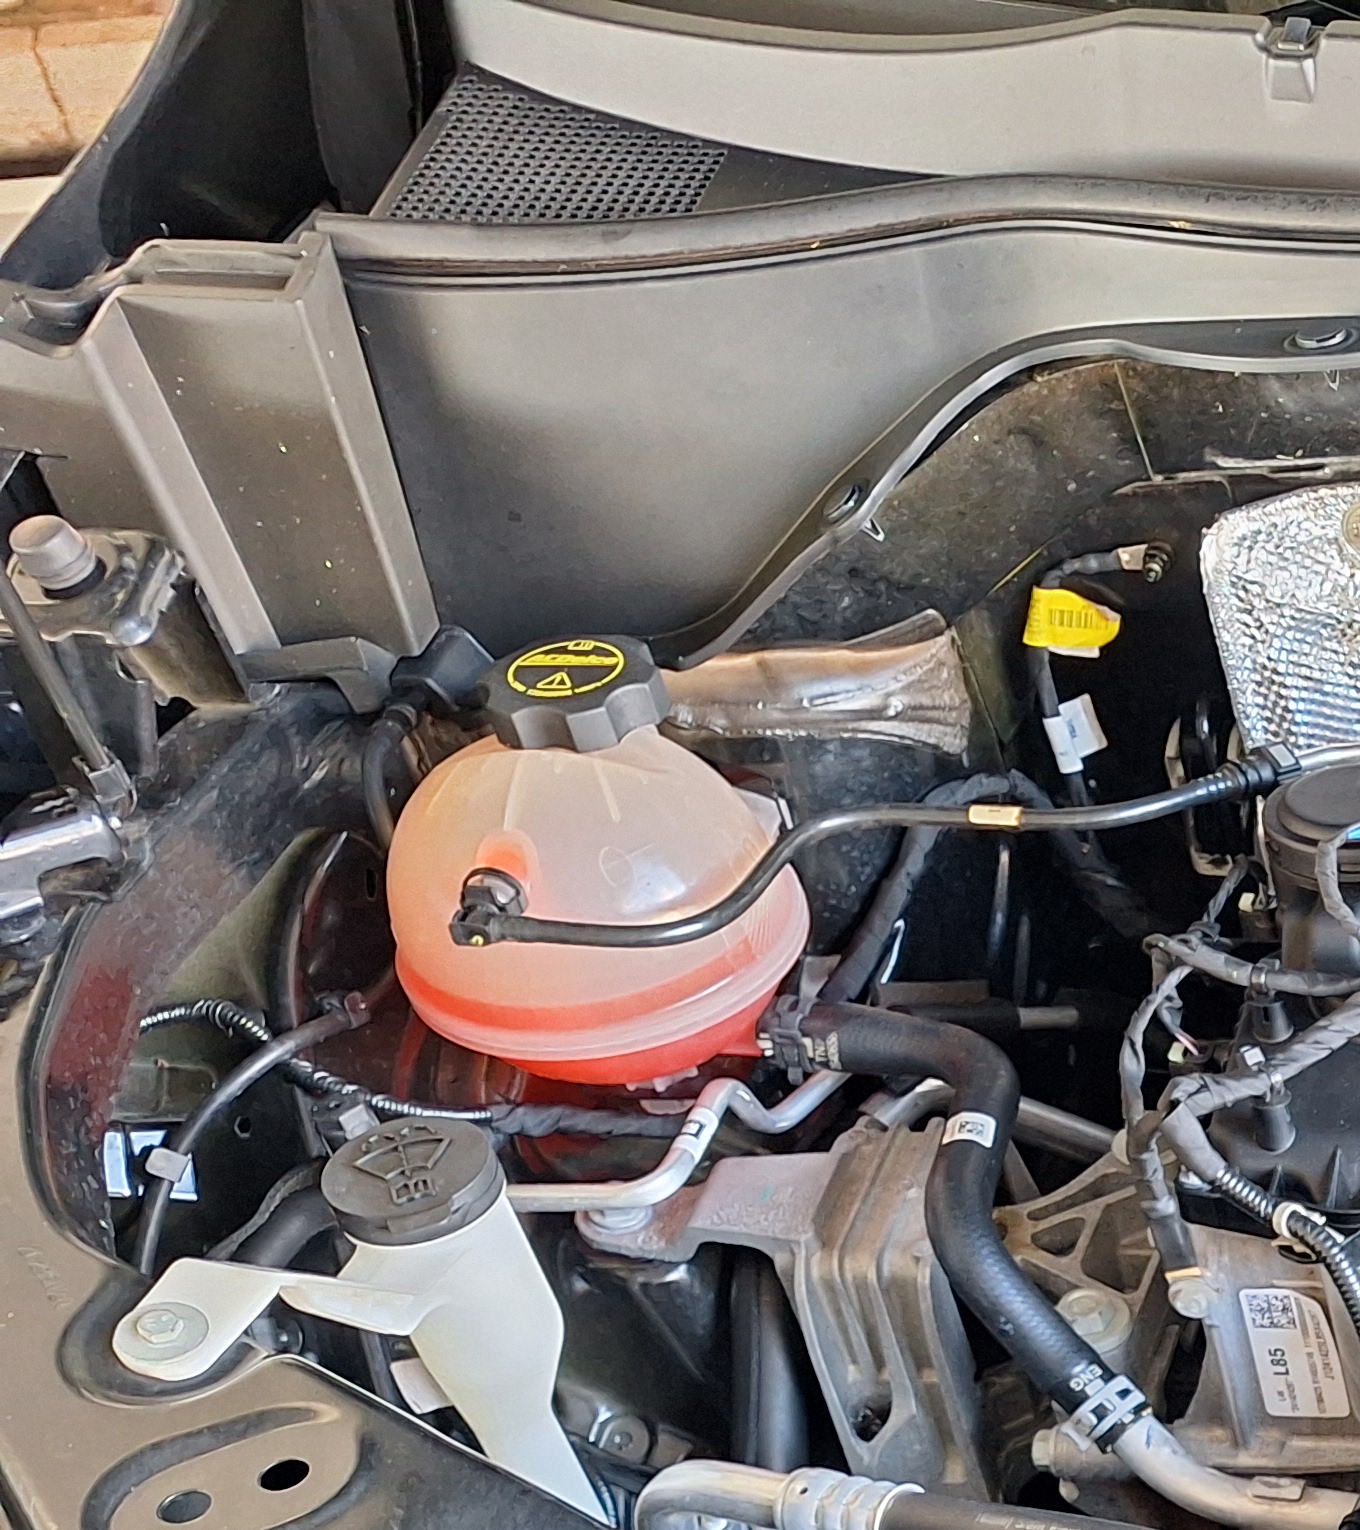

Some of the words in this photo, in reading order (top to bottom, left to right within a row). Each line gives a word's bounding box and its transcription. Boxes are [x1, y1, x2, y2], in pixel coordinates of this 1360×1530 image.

[525, 653, 619, 666] ACDelco
[1268, 1347, 1290, 1376] L85
[1069, 1363, 1104, 1392] ENG
